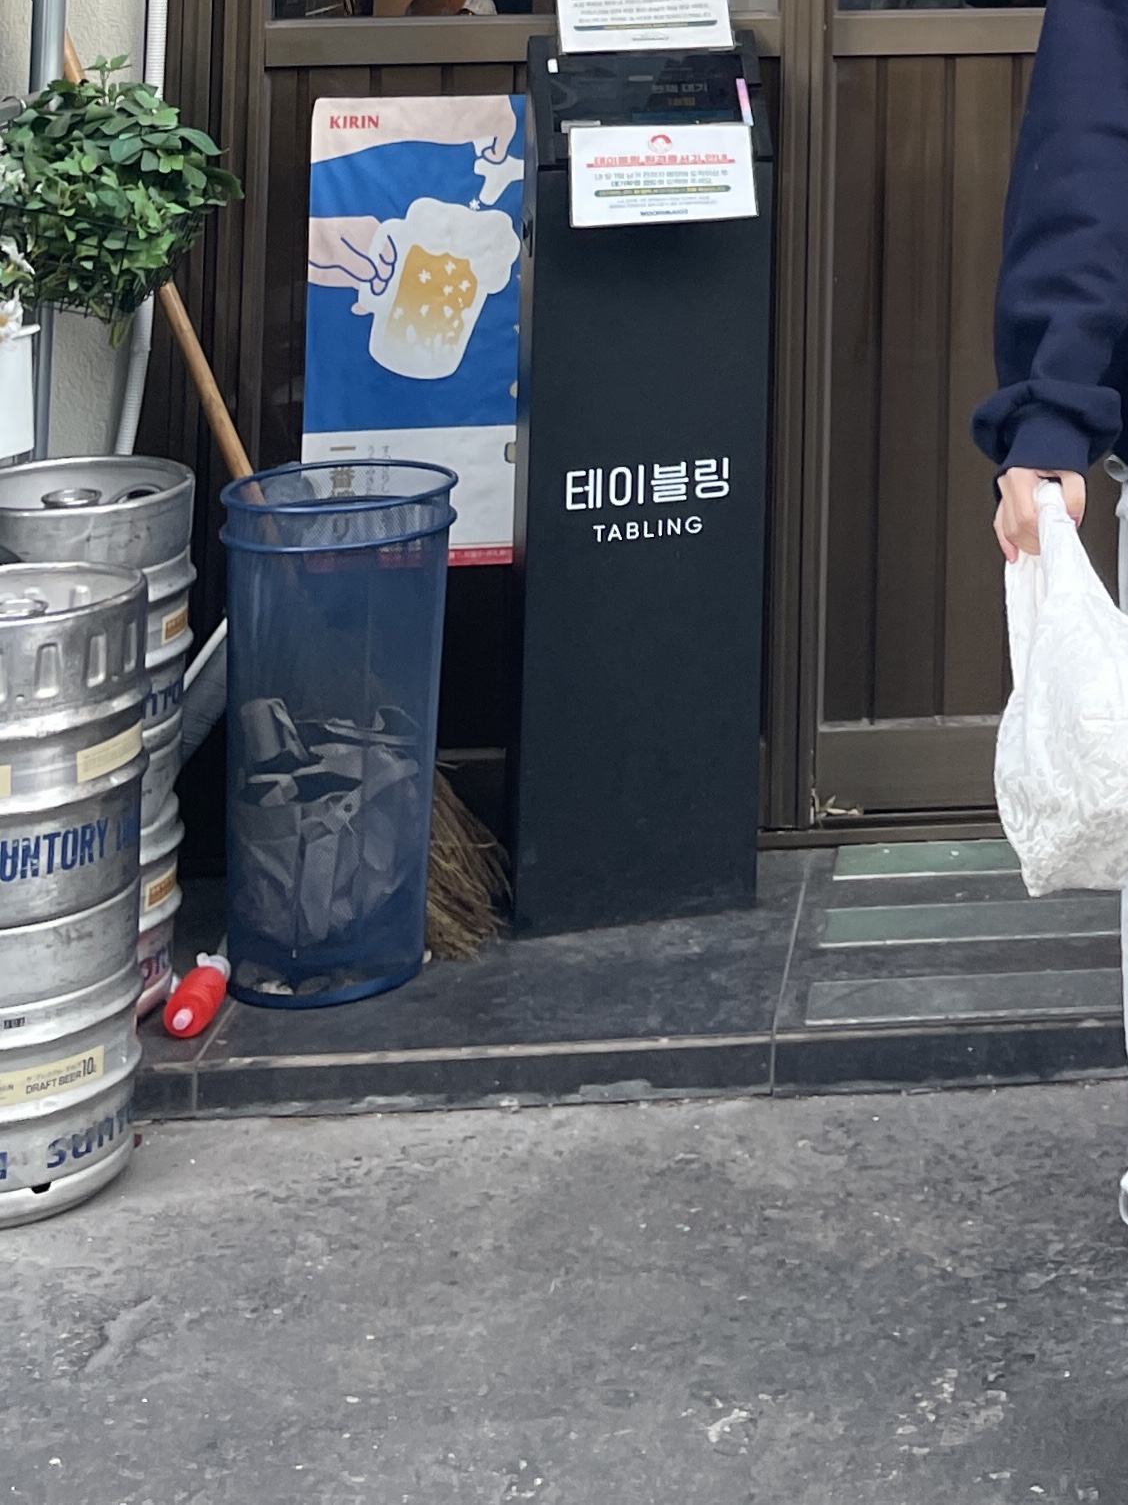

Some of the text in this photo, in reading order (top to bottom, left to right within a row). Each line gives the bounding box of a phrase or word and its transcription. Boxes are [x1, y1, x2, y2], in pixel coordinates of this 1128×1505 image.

[329, 115, 379, 129] KIRIN
[566, 447, 730, 511] 테이블링
[593, 516, 703, 542] TABLING
[25, 1078, 57, 1095] DRAFT
[58, 1070, 81, 1086] BEER
